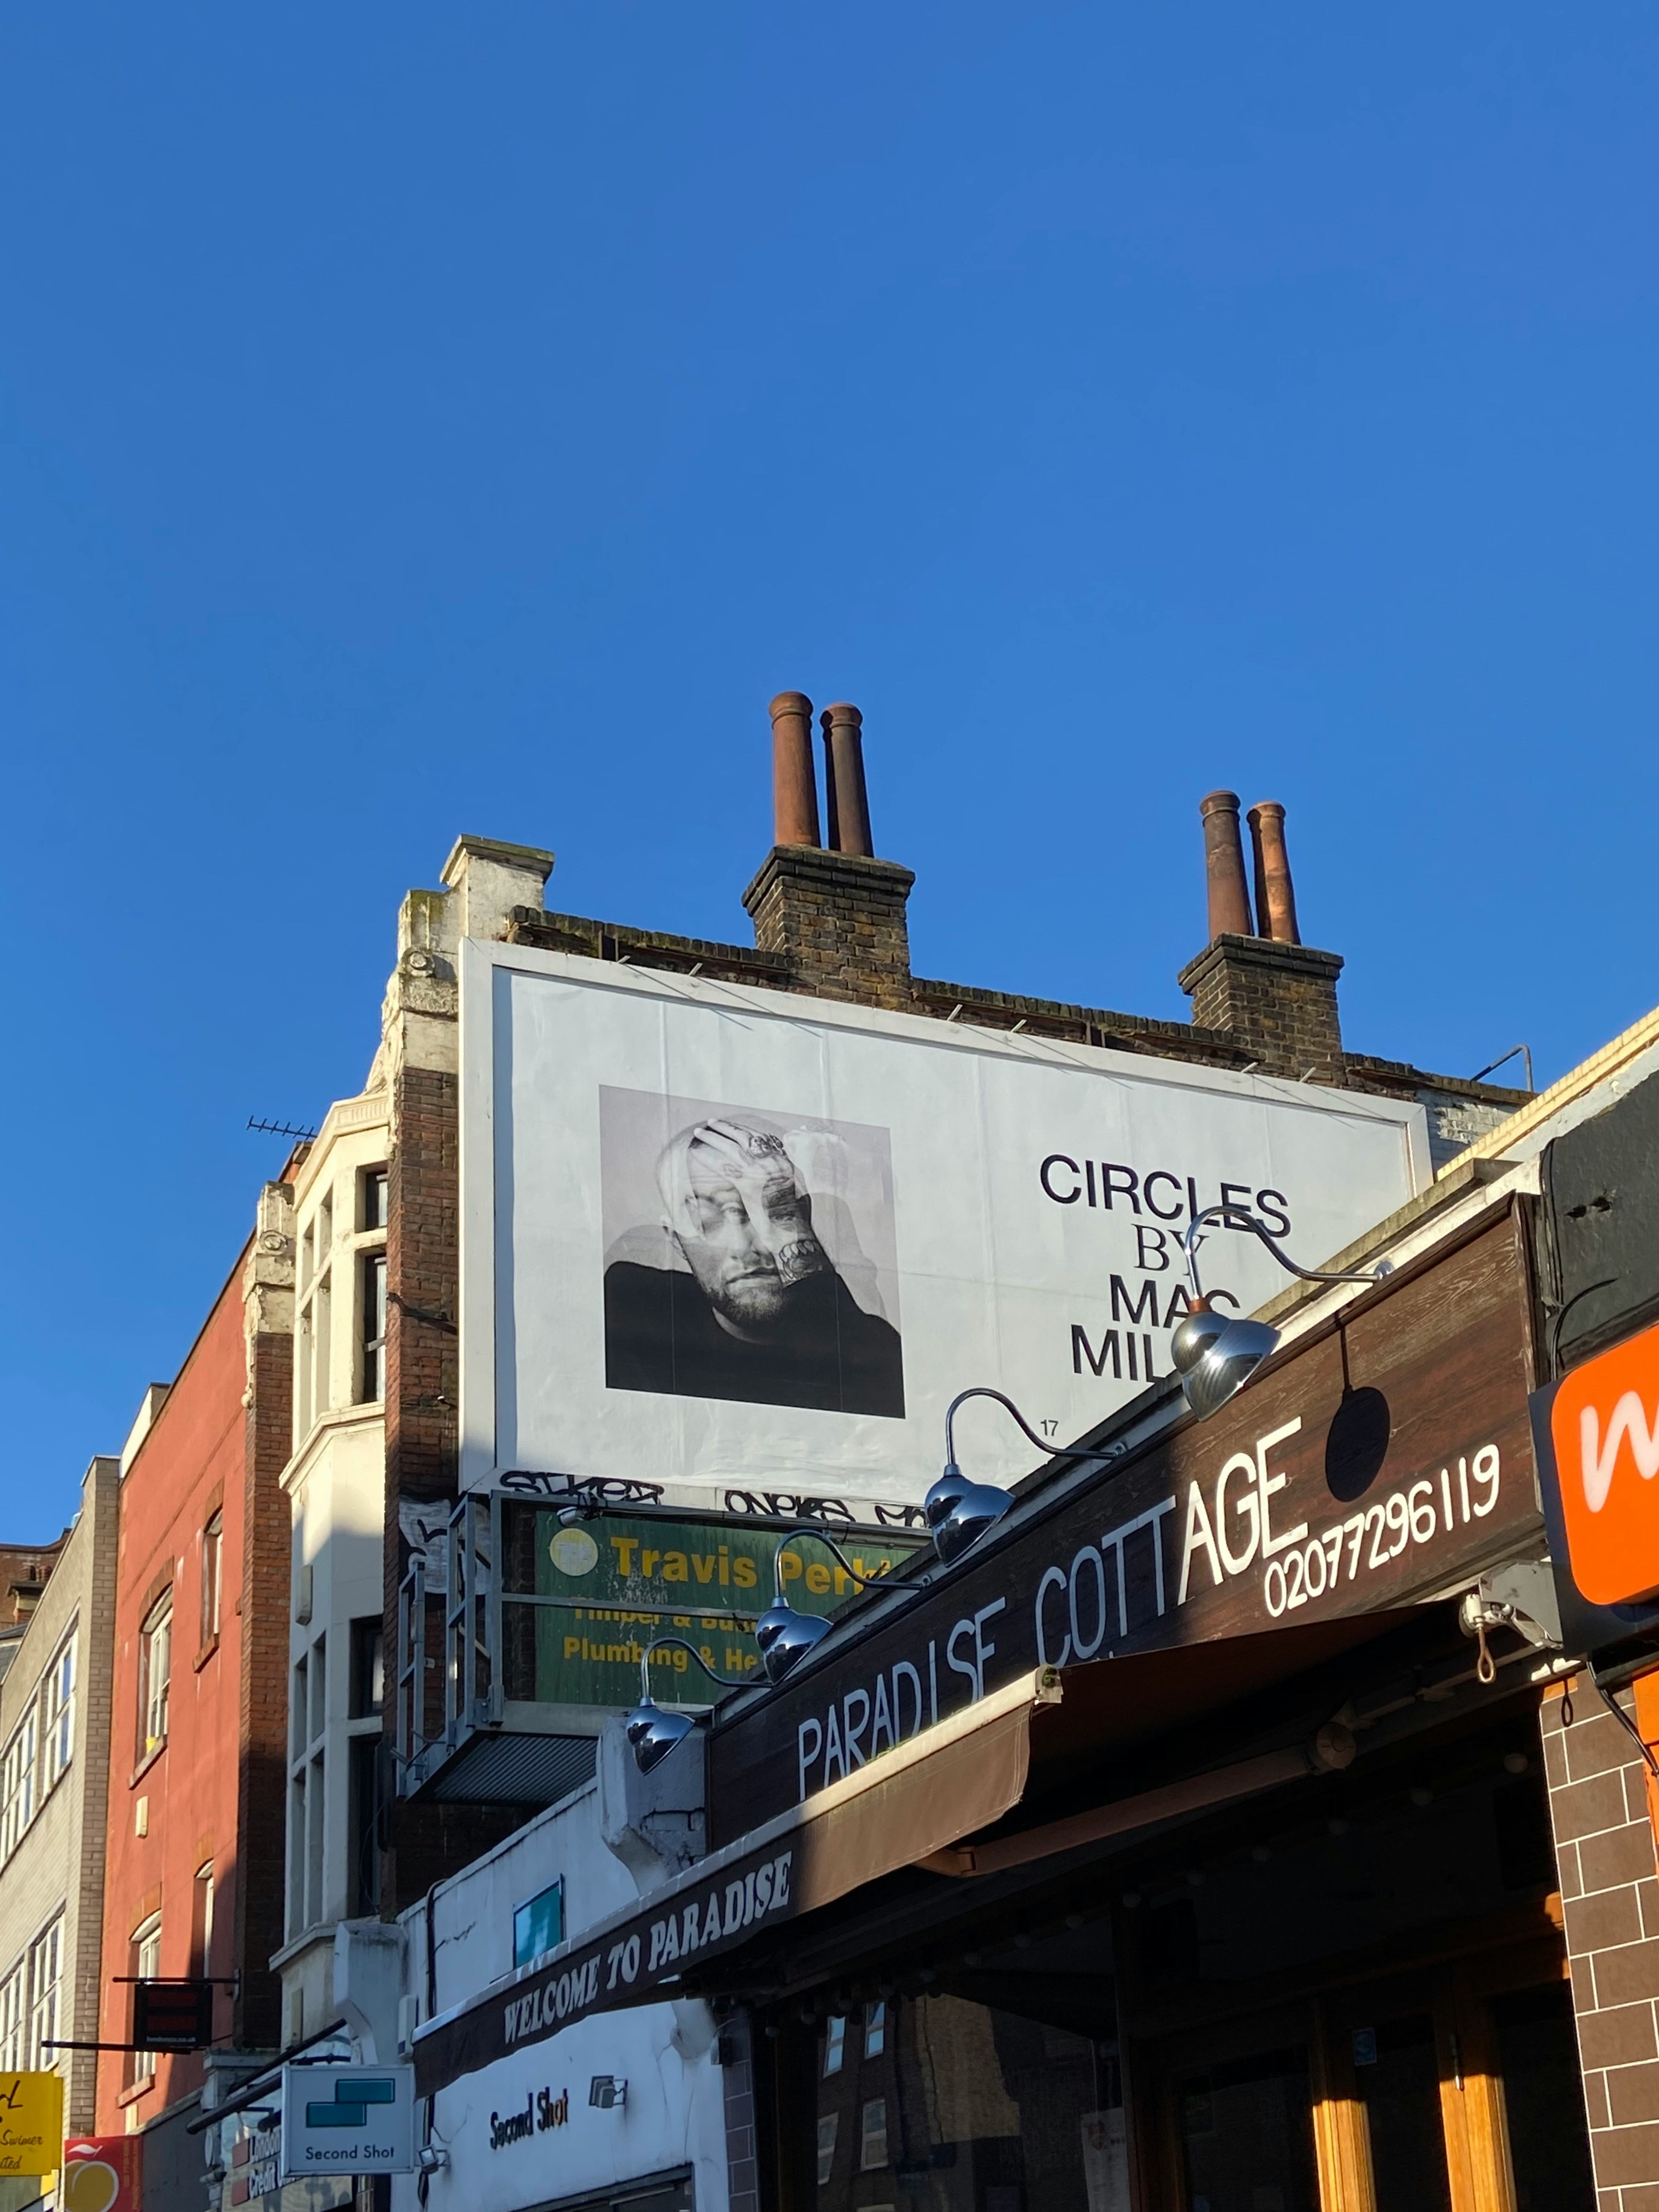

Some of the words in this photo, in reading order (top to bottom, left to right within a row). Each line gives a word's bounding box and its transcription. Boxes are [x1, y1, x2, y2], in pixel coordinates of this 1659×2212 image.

[1040, 1154, 1290, 1238] CIRCLES
[1132, 1224, 1209, 1276] BY
[1071, 1324, 1170, 1383] MIL
[1040, 1419, 1059, 1437] 17
[611, 1537, 757, 1589] Travis
[780, 1551, 890, 1595] Perk
[798, 1597, 1007, 1802] PARADISE
[1034, 1416, 1308, 1669] COTTAGE
[563, 1636, 688, 1672] Plumbing
[503, 1954, 601, 2045] WELCOME
[606, 1934, 642, 1990] TO
[648, 1851, 793, 1972] PARADISE
[490, 2092, 534, 2151] Second
[537, 2087, 569, 2132] Shot
[305, 2145, 358, 2160] Second
[363, 2145, 395, 2158] Shot
